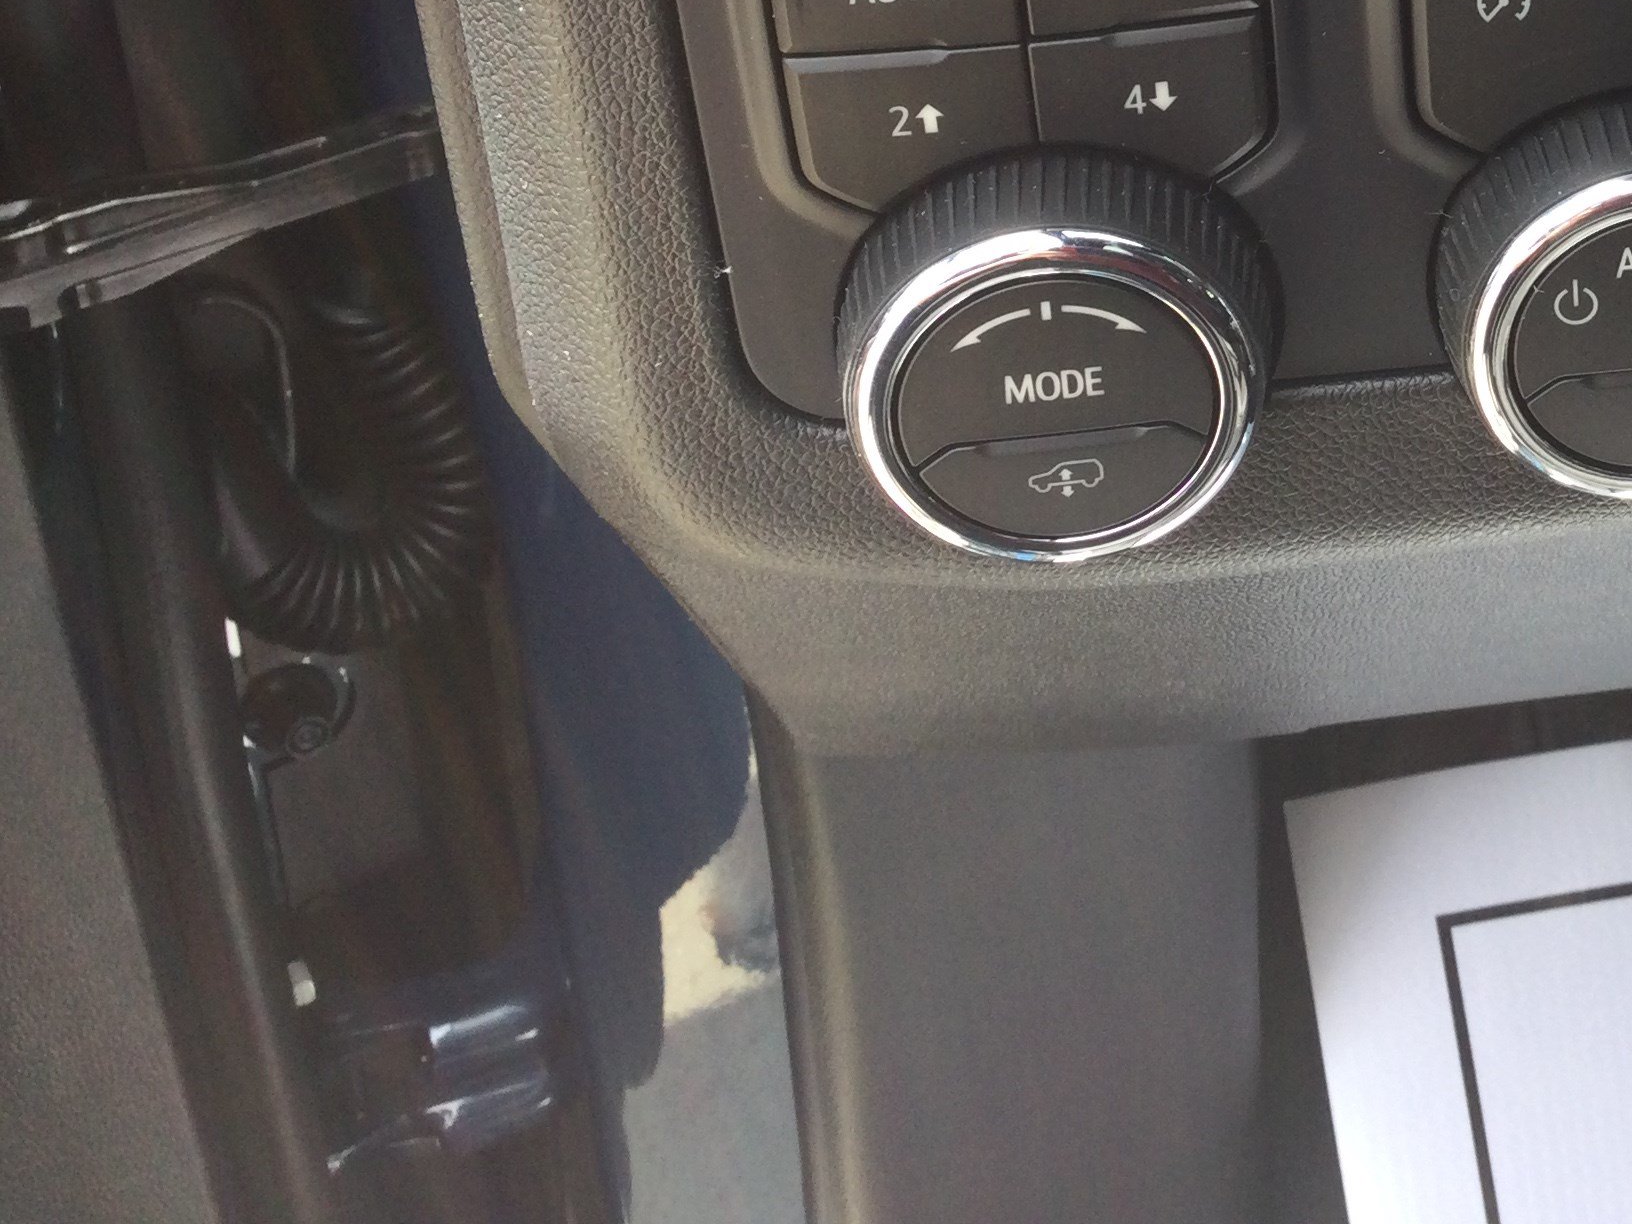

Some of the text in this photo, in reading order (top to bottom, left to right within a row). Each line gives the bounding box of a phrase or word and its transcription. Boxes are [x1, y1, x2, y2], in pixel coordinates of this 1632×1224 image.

[1123, 84, 1146, 115] 4
[888, 106, 912, 137] 2
[1004, 366, 1105, 404] MODE
